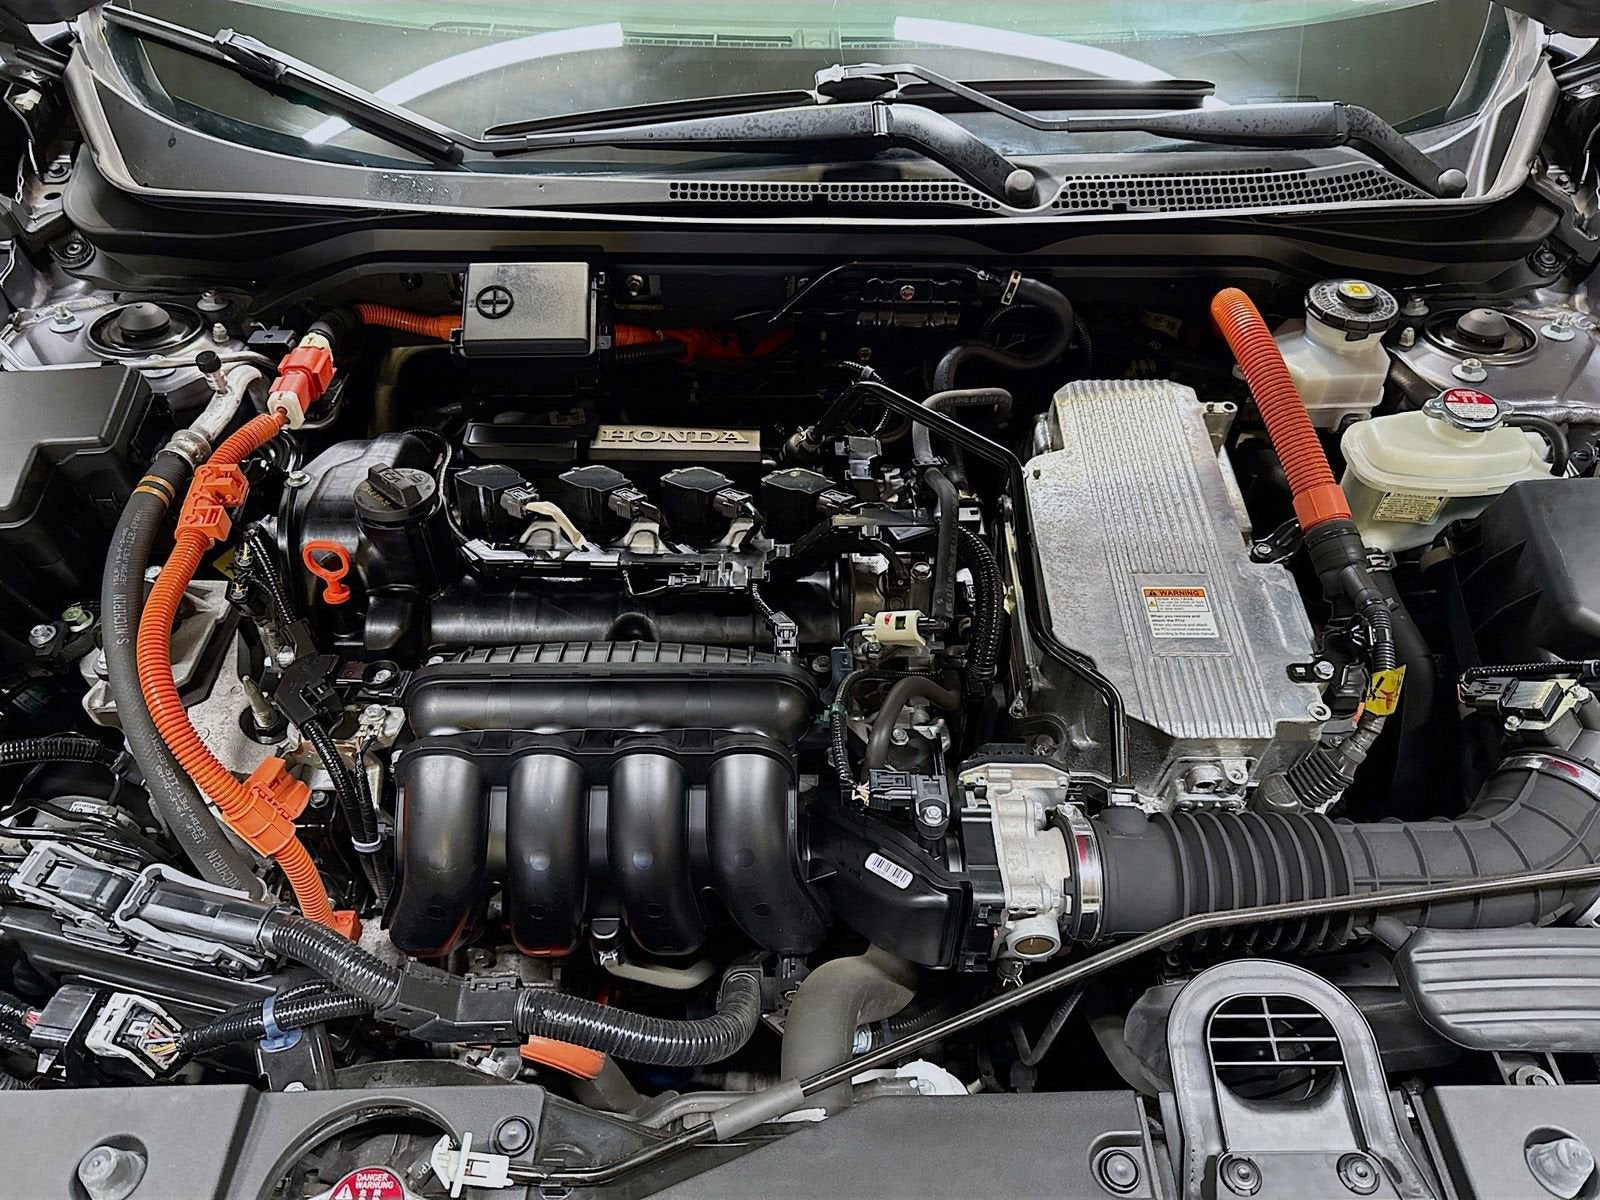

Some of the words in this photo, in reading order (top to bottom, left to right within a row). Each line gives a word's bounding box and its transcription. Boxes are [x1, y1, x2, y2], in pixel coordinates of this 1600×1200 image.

[601, 429, 749, 443] HONDA
[356, 1173, 389, 1181] DANGER
[355, 1181, 394, 1189] WARNUNG
